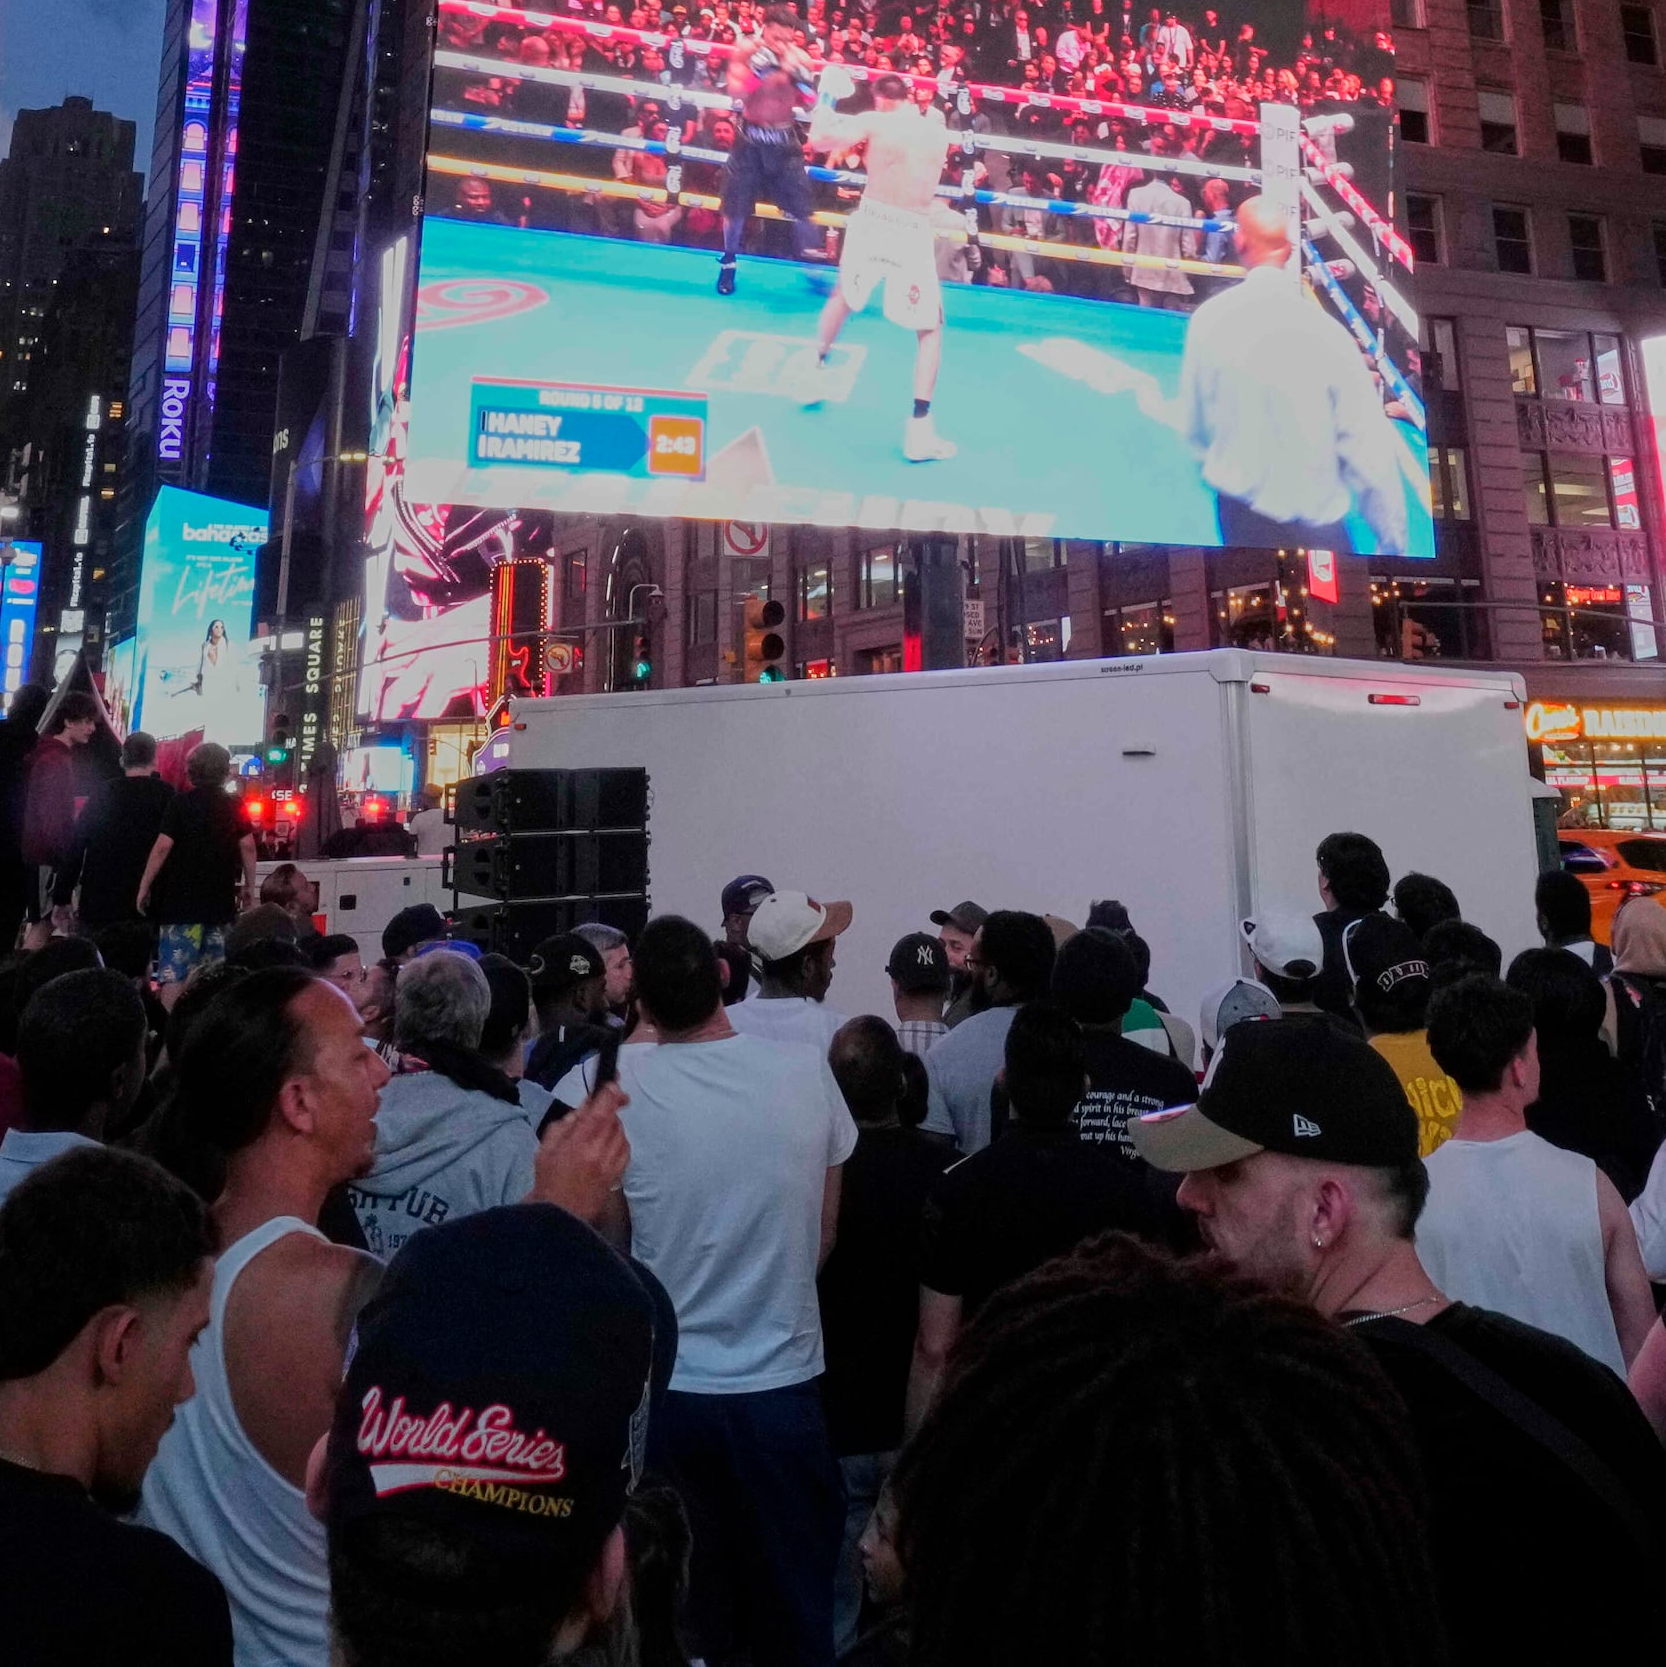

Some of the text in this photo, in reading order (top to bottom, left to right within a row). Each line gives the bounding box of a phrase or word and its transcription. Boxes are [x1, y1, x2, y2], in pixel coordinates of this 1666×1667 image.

[488, 413, 562, 437] HANEY
[487, 437, 581, 463] RAMIREZ
[305, 615, 324, 694] SQUARE
[1081, 1103, 1102, 1116] spirit
[1104, 1104, 1111, 1113] in
[1113, 1102, 1125, 1114] his
[1086, 1091, 1115, 1103] courage
[1117, 1090, 1135, 1102] and
[357, 1385, 565, 1472] World Series
[435, 1469, 574, 1518] CHAMPIONS
